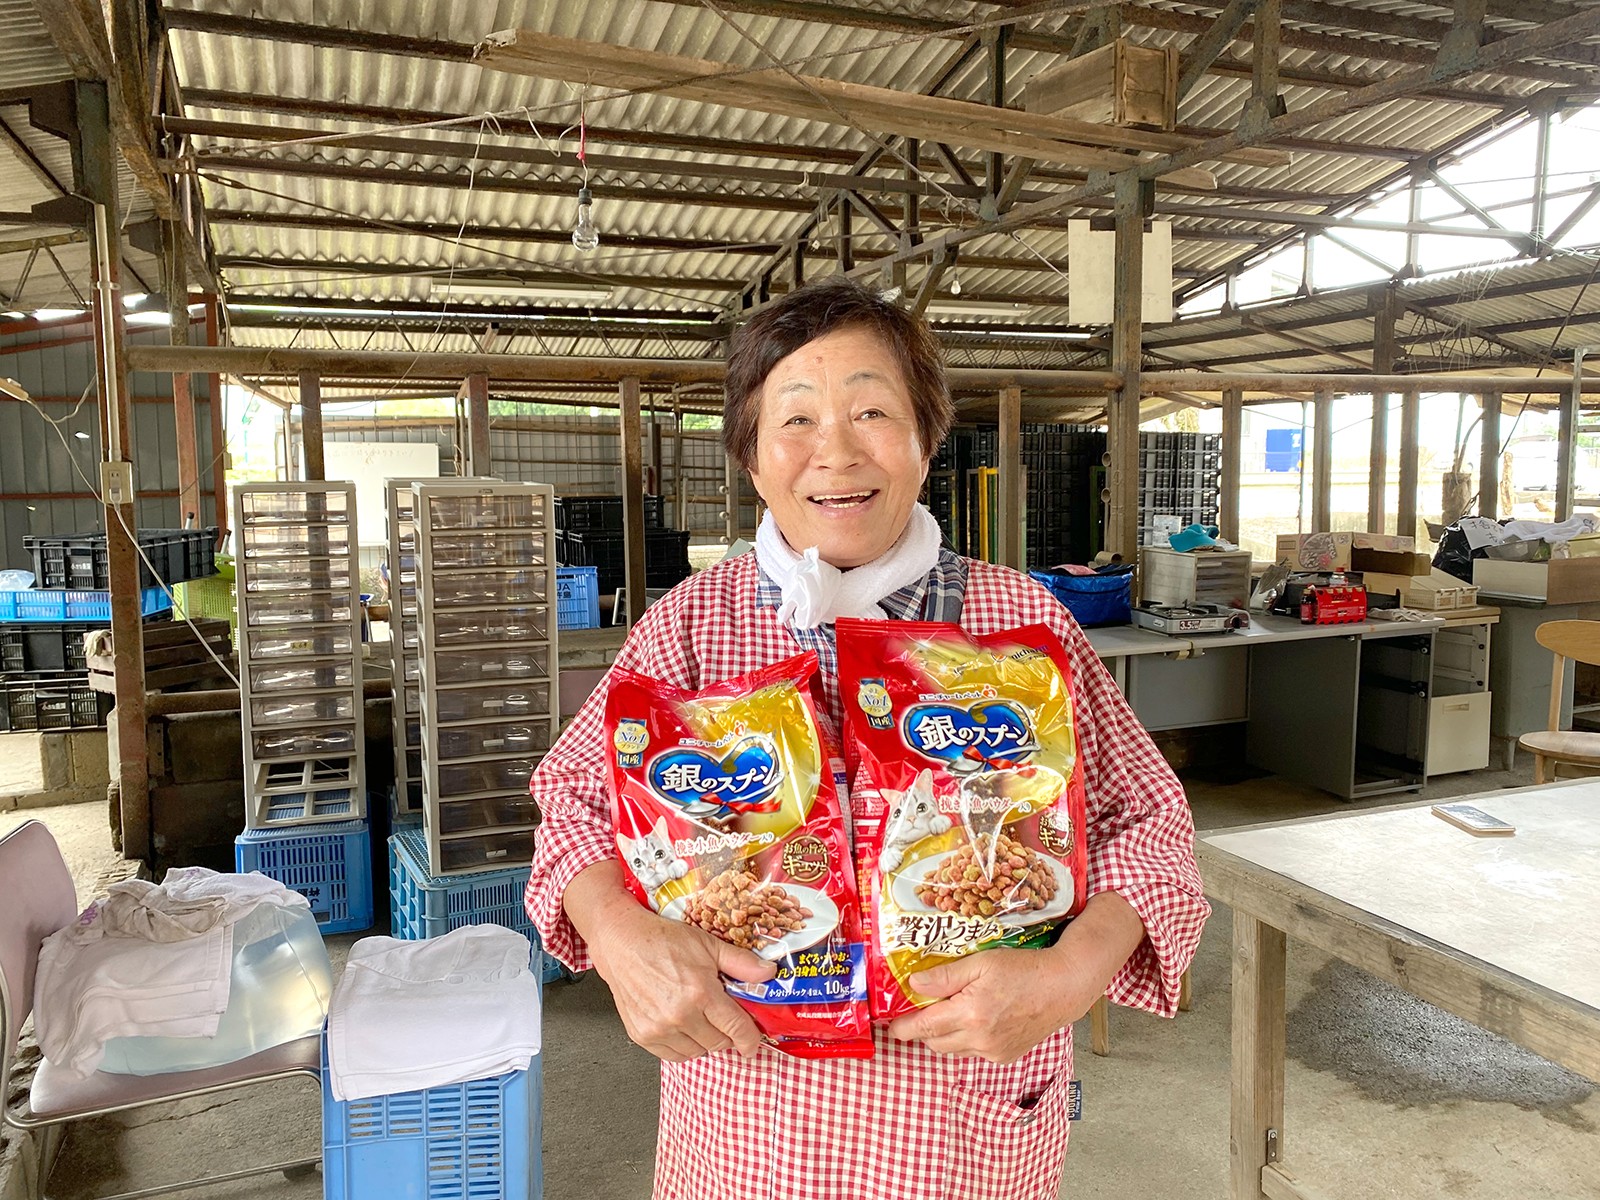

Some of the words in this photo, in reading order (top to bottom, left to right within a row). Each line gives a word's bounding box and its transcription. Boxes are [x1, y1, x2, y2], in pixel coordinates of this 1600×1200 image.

[914, 715, 1029, 751] 銀のスプーン
[660, 763, 774, 793] 銀のスプーン
